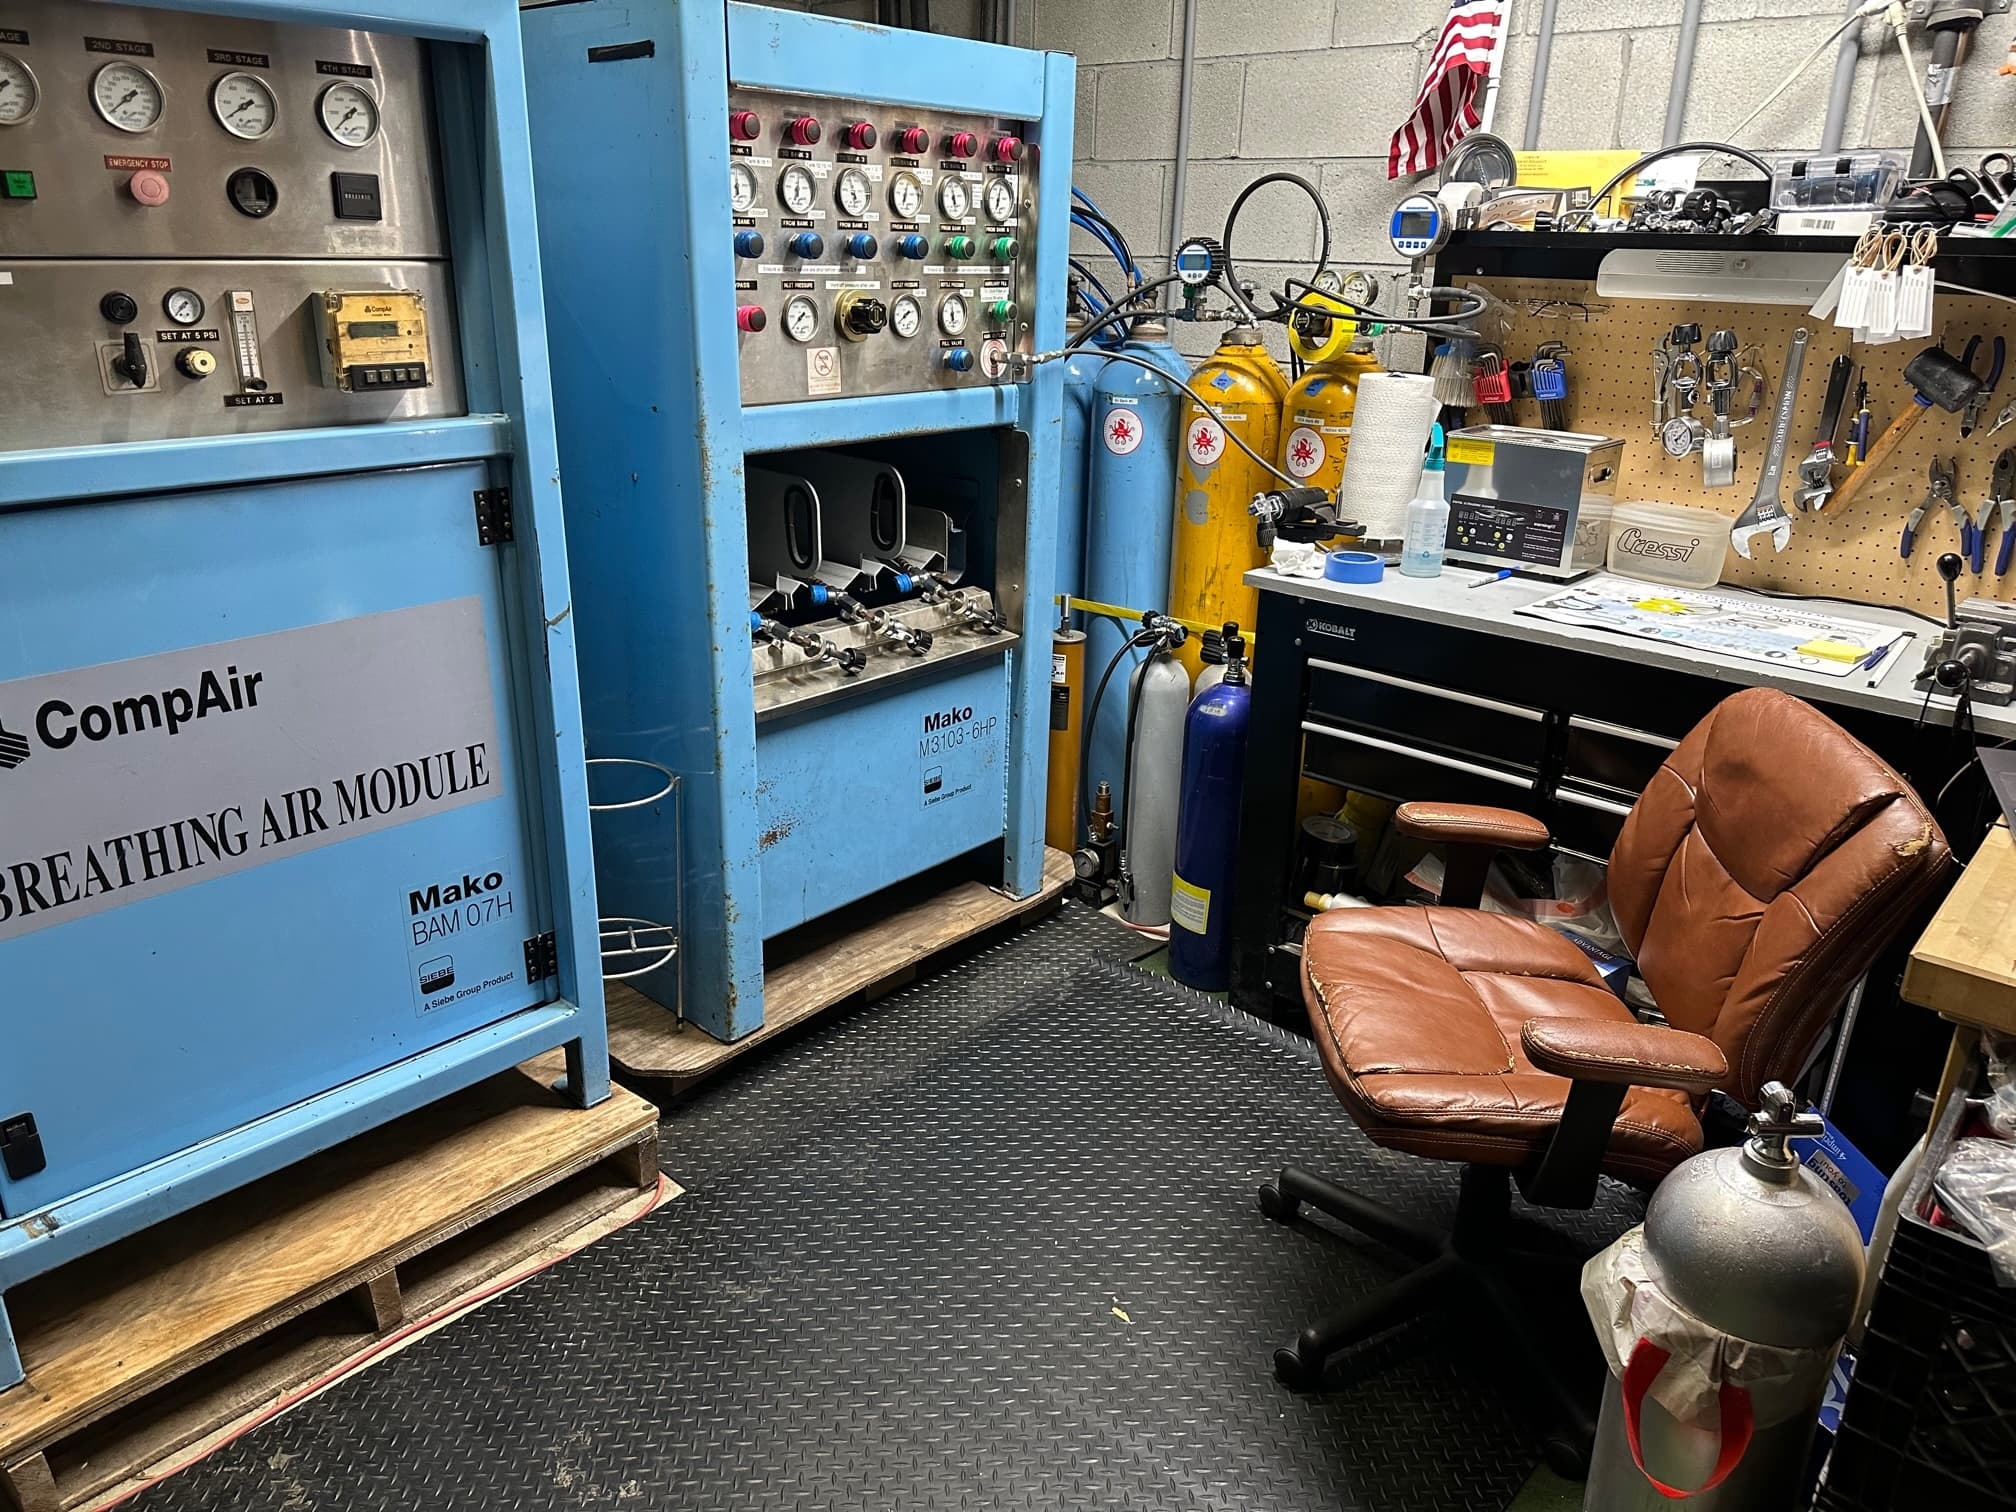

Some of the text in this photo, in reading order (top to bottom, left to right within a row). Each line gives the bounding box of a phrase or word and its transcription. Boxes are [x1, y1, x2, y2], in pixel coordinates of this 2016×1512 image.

[92, 40, 146, 53] 2ND STAGE
[213, 53, 264, 65] 3RD STAGE
[321, 64, 369, 76] 4TH STAGE
[109, 158, 169, 169] EMERGENCY STOP
[371, 305, 392, 314] CompAir
[161, 331, 217, 341] SET AT 5 PSI
[235, 396, 274, 405] SET AT 2
[1617, 528, 1700, 563] Cressi
[1319, 621, 1356, 637] KOBALT
[36, 665, 263, 749] CompAir
[924, 706, 973, 734] Mako
[260, 786, 329, 848] AIR
[333, 743, 490, 826] MODULE
[941, 789, 955, 802] Group
[955, 783, 972, 795] Product
[408, 870, 504, 916] Mako
[412, 891, 513, 946] BAM 07H
[1574, 938, 1613, 961] ADVANTAGE
[419, 966, 455, 984] SIEBE
[423, 972, 514, 1012] A Siebe Group Product
